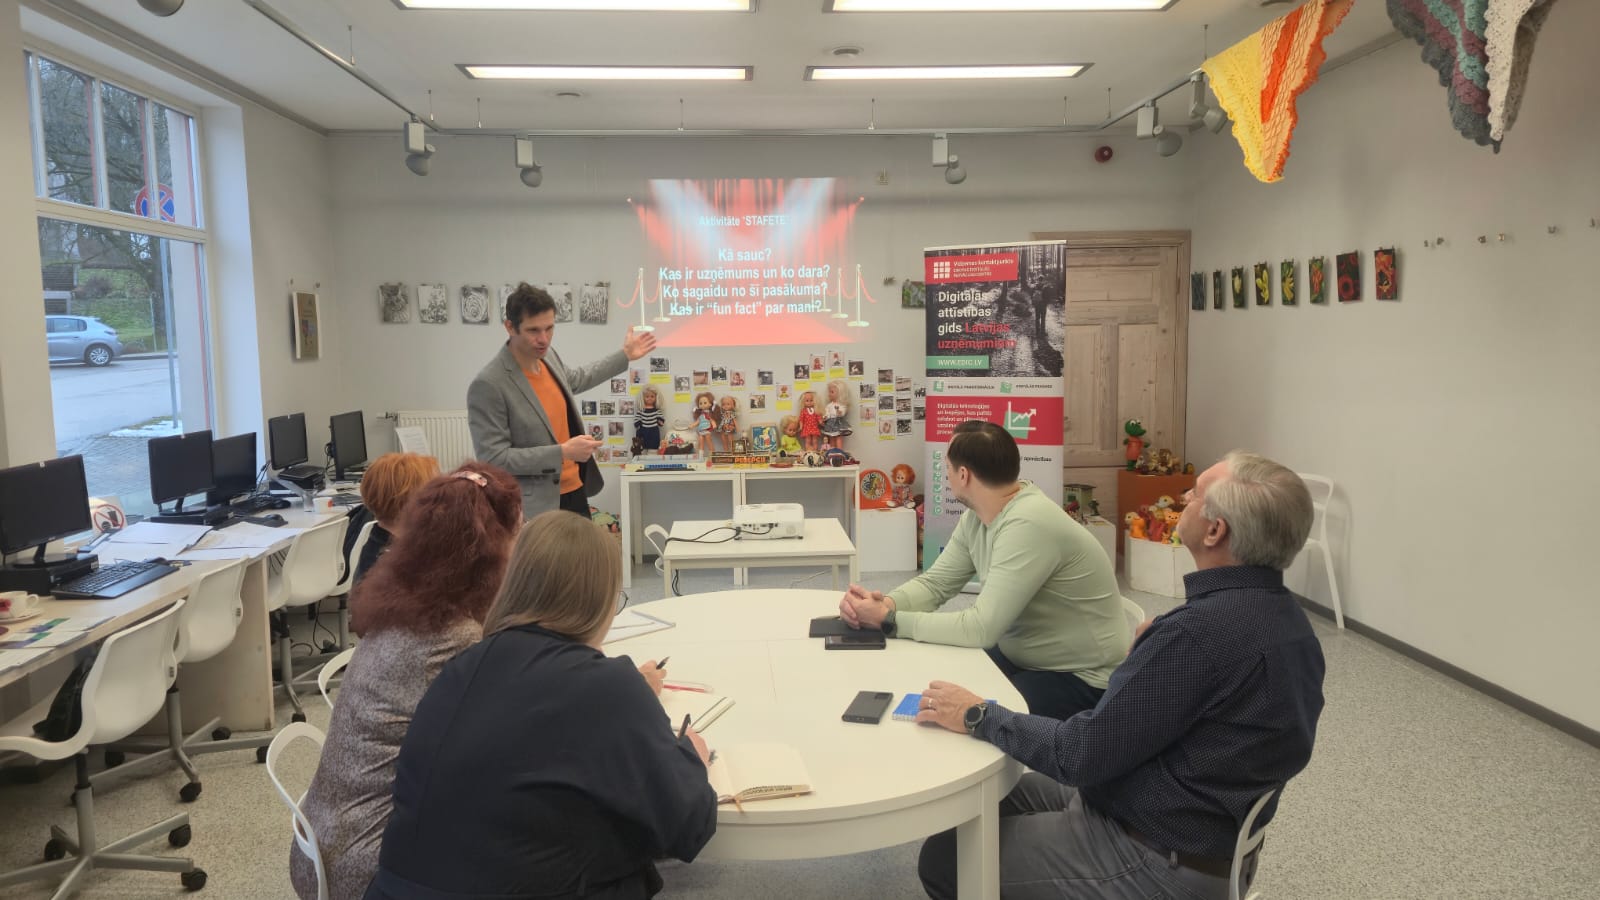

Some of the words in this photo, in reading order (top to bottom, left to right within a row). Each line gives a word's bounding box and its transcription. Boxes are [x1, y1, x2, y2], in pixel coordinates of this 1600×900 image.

[699, 215, 740, 226] Aktivitāte
[719, 248, 733, 261] Kā
[737, 247, 772, 261] sauc?
[659, 267, 682, 280] Kas
[685, 267, 693, 279] ir
[697, 267, 759, 282] uzņēmums
[763, 269, 777, 279] un
[781, 266, 794, 278] ko
[798, 265, 830, 278] dara?
[663, 285, 679, 297] Ko
[682, 285, 728, 300] sagaidu
[732, 287, 746, 297] no
[749, 284, 760, 297] šī
[763, 282, 828, 298] pasākuma?
[670, 303, 692, 315] Kas
[696, 303, 704, 314] ir
[765, 303, 784, 316] par
[787, 301, 822, 313] mani?
[938, 307, 992, 318] attīstības
[938, 321, 962, 336] gids
[965, 321, 1011, 335] Latvijas
